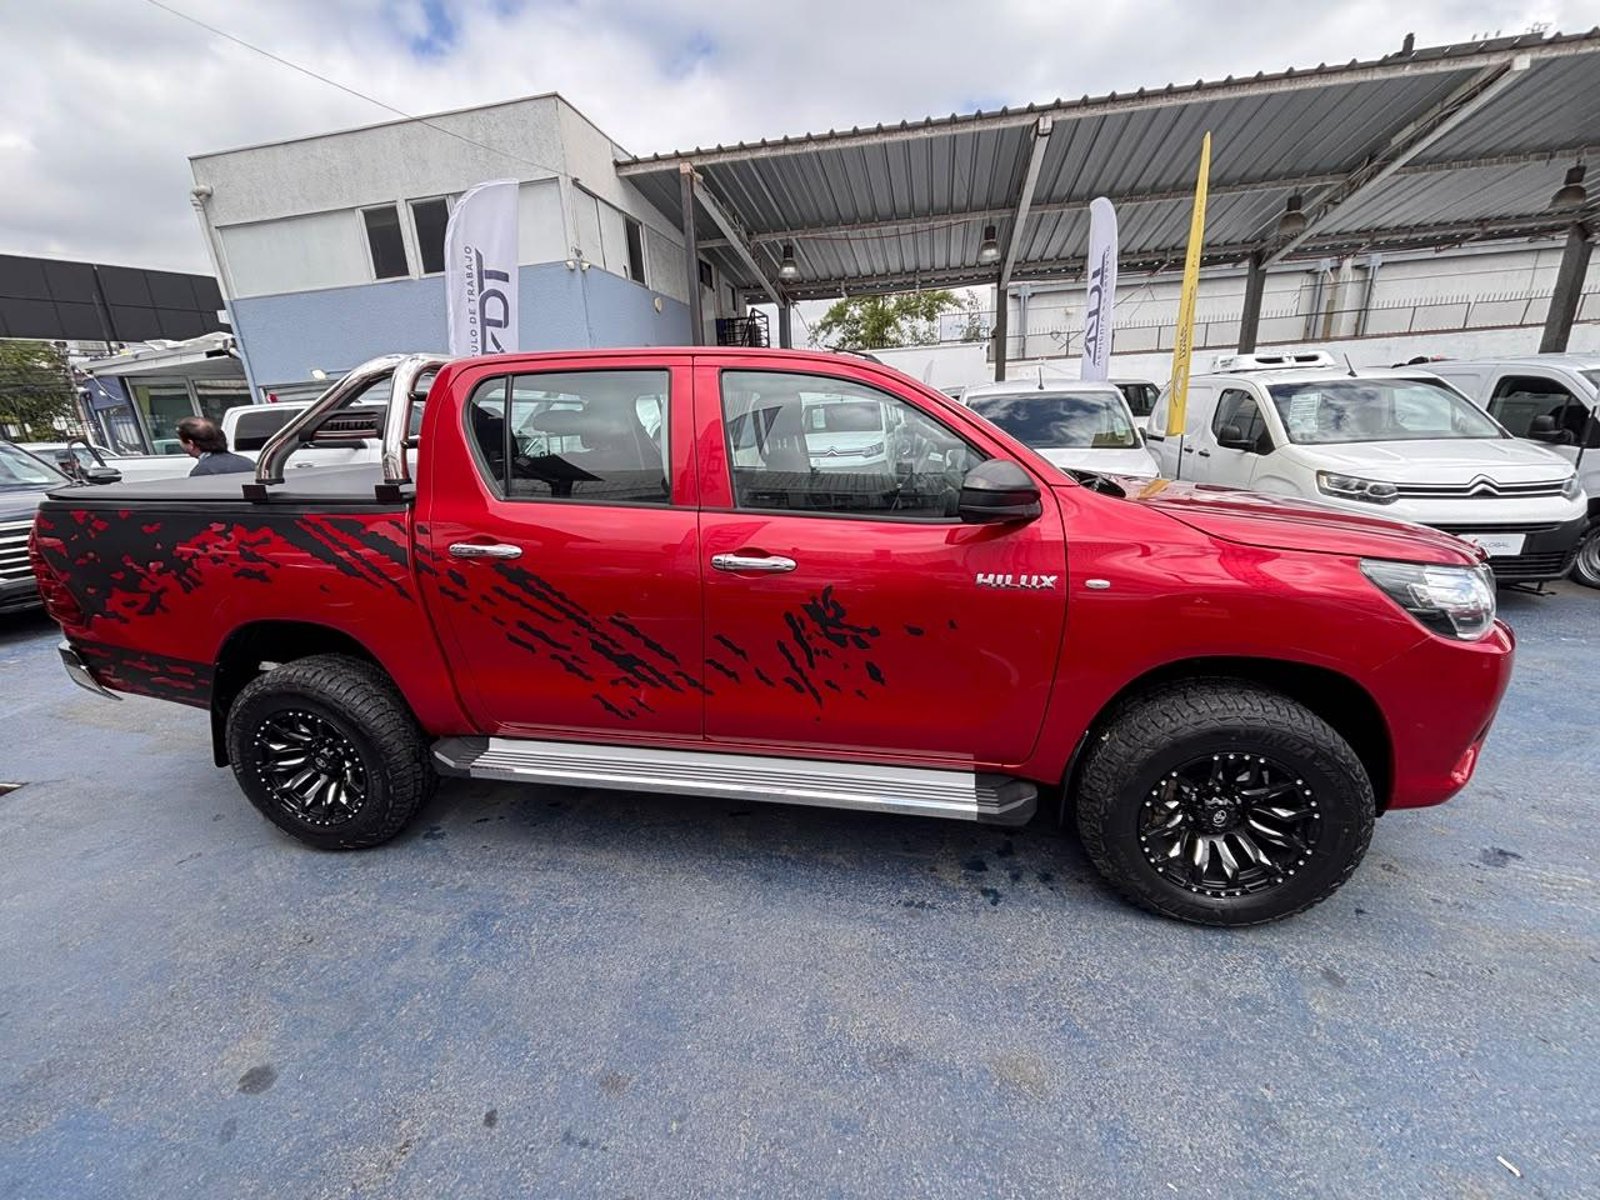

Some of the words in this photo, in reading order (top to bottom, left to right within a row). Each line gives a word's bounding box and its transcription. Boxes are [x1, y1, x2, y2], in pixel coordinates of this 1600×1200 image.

[464, 245, 476, 304] TRABAJO
[468, 307, 477, 325] DE
[328, 420, 375, 431] HILUX
[976, 573, 1058, 589] HILUX
